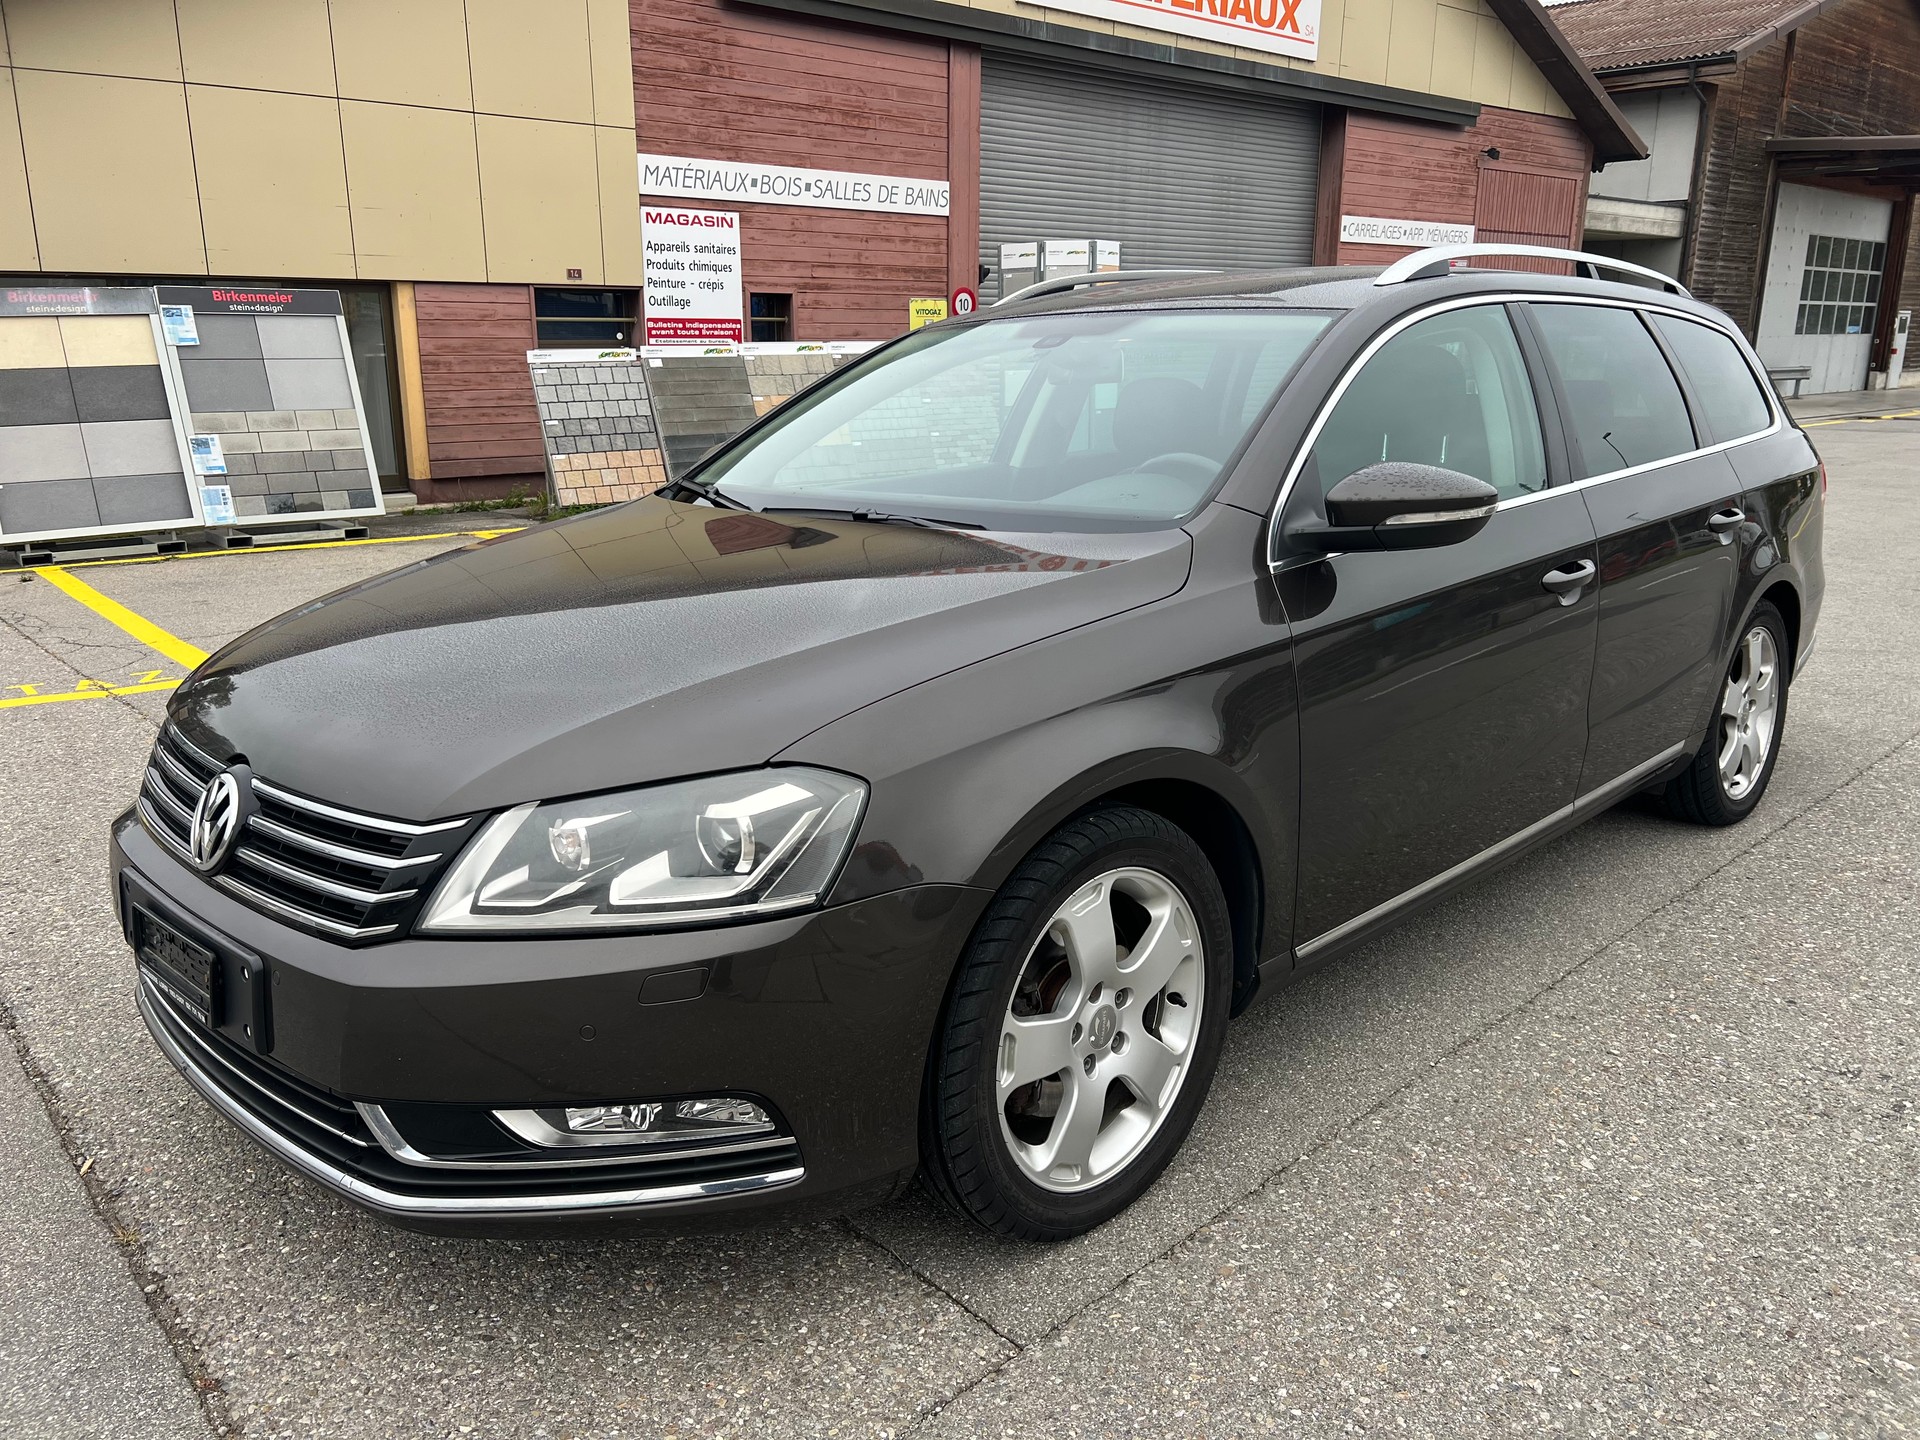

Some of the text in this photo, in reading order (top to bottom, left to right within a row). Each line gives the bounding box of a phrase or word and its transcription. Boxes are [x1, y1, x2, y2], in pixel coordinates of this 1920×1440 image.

[1305, 24, 1314, 37] SA
[643, 163, 949, 208] MATÉRIAUX BOIS SALLES DE BAINS
[645, 211, 734, 228] MAGASIN
[1347, 222, 1469, 244] CARRELAGES APP. MÉNAGERS
[646, 240, 737, 255] Appareils sanitaires
[570, 269, 579, 278] 14
[646, 258, 733, 275] Produits chimiques
[647, 277, 686, 289] Peinture
[698, 278, 724, 292] crépis
[7, 289, 99, 303] Birkenmeir
[212, 290, 293, 303] Birkenmeier
[648, 295, 691, 310] Outillage
[958, 298, 969, 311] 10
[915, 308, 942, 316] VITOGAZ
[647, 321, 741, 330] Bulletins indispensables
